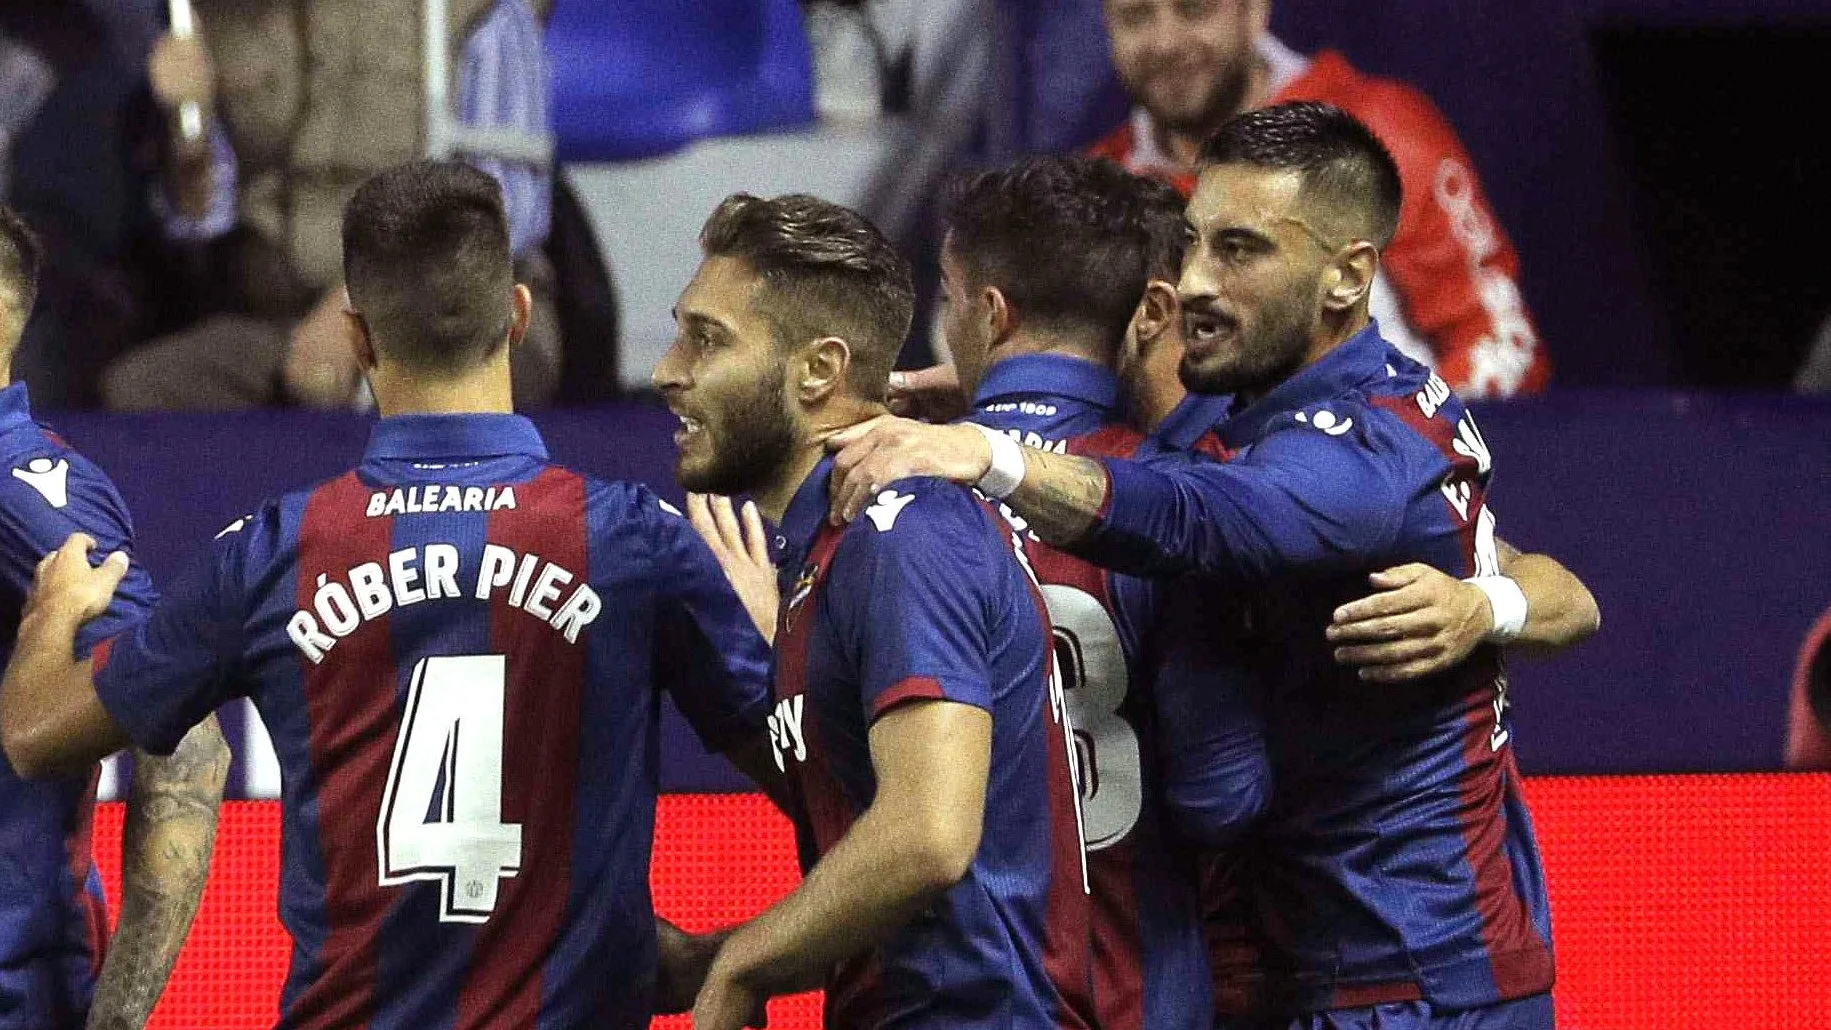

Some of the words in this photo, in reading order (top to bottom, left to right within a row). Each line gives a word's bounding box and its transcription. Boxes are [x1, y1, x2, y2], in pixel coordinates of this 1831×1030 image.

[366, 485, 517, 518] BALEARIA
[286, 543, 462, 665] RÓBER
[475, 543, 603, 645] PIER
[376, 654, 522, 924] 4
